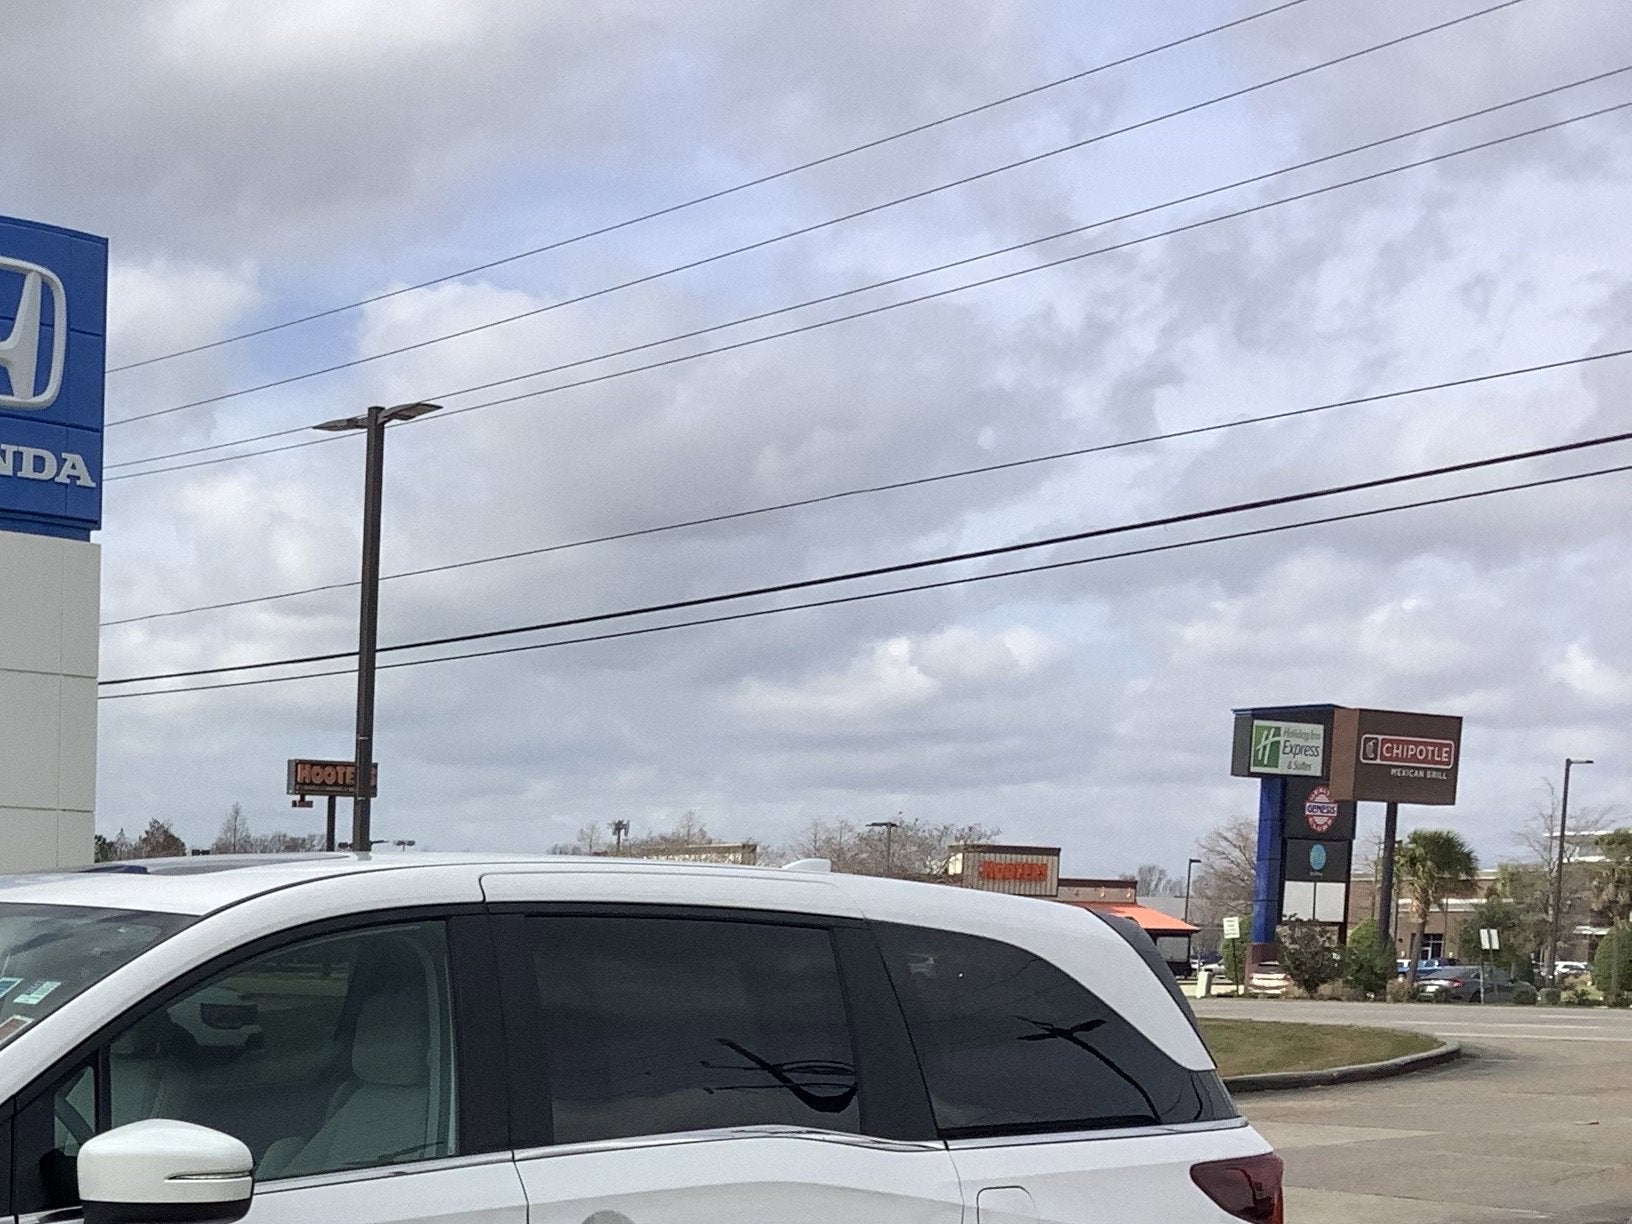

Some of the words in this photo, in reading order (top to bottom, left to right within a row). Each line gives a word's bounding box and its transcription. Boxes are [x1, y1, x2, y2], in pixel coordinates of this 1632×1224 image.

[1282, 740, 1320, 758] Express
[1382, 743, 1450, 762] CHIPOTLE
[297, 763, 377, 786] HOOTES
[1390, 768, 1425, 778] MEXICAN
[1426, 770, 1448, 780] GRILL
[1307, 804, 1336, 815] GENESIS
